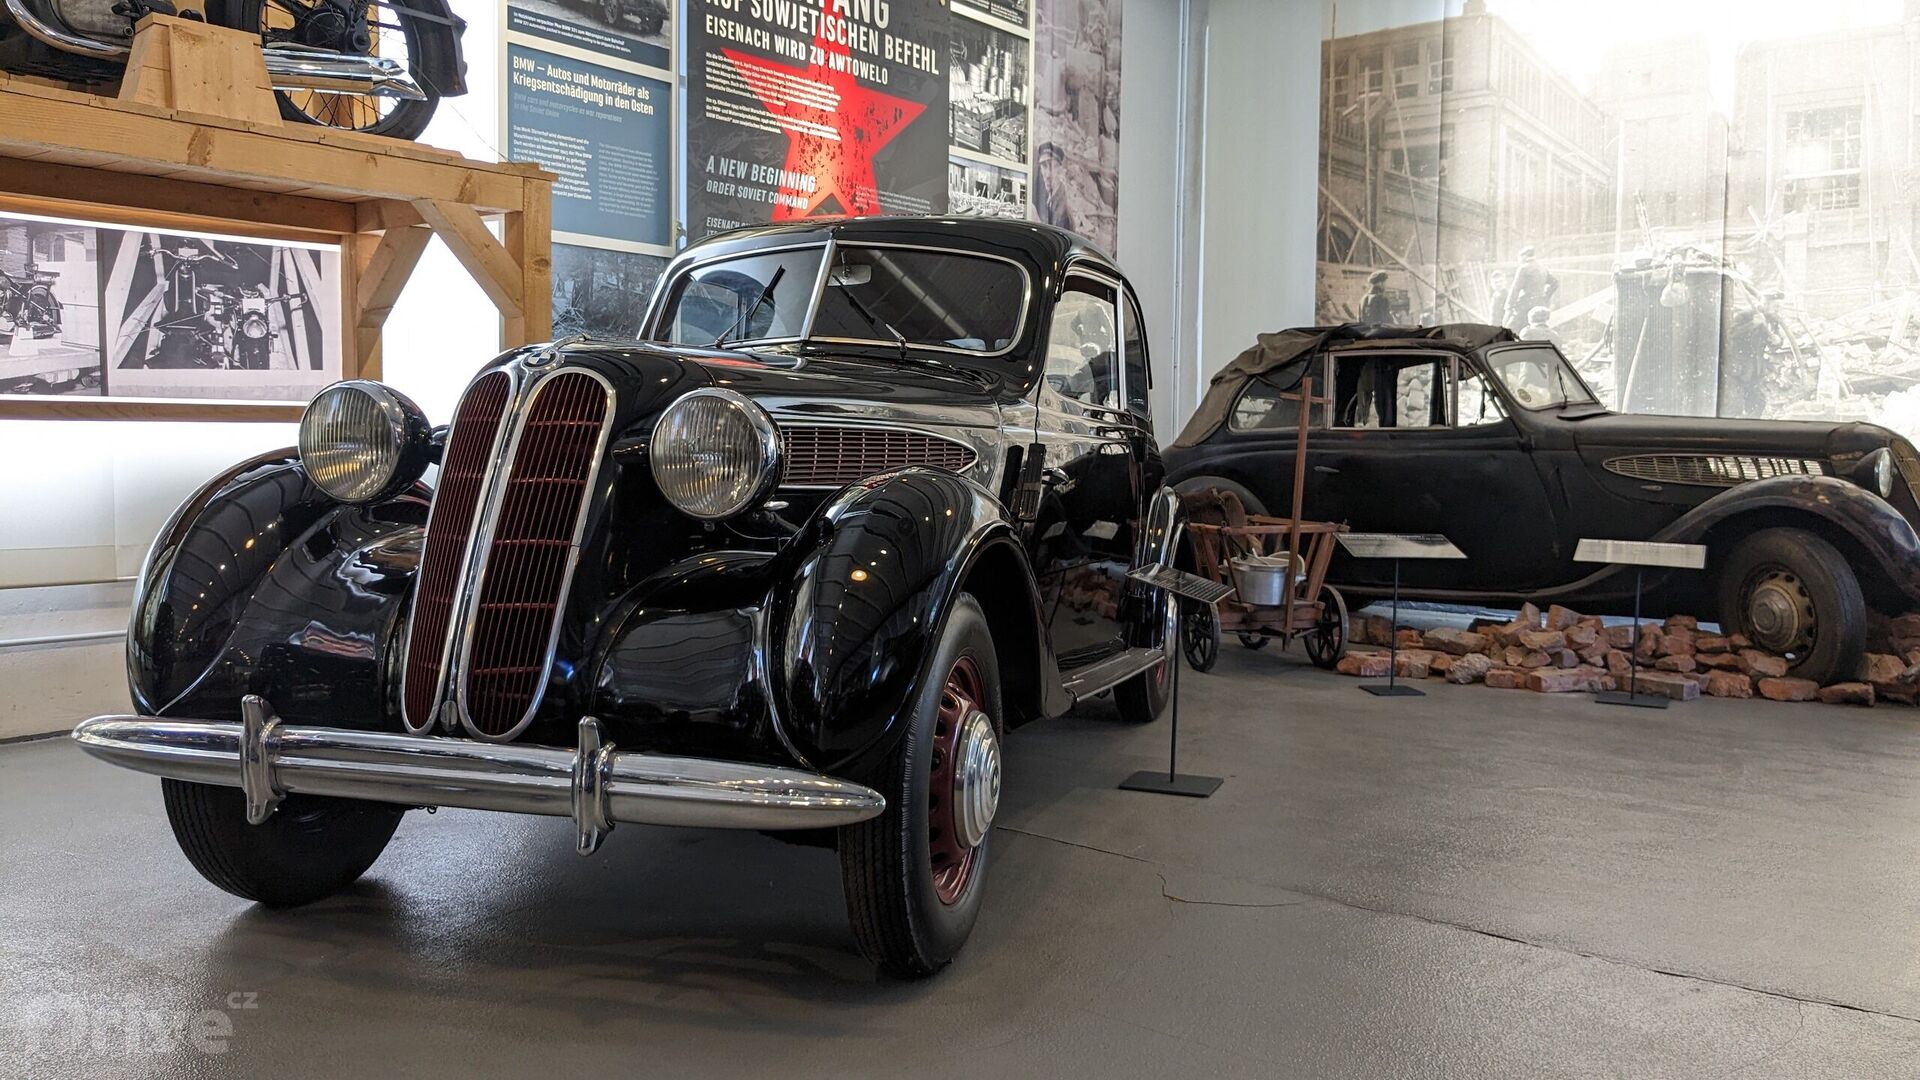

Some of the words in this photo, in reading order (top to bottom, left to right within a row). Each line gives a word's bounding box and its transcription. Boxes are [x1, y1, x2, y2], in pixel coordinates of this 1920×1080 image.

[706, 13, 770, 51] EISENACH
[774, 33, 806, 61] WIRD
[809, 45, 825, 67] ZU
[828, 51, 888, 85] AWTOWELO
[750, 0, 879, 56] SOWJETISCHEN
[884, 33, 940, 76] BEFEHL
[513, 55, 535, 73] BMW
[547, 64, 572, 82] Autos
[573, 72, 590, 86] und
[590, 74, 636, 97] Motorräder
[637, 86, 650, 100] als
[513, 71, 604, 107] Kriegsentschädigung
[605, 92, 614, 106] in
[614, 95, 630, 110] den
[631, 98, 654, 116] Osten
[705, 155, 715, 174] A
[719, 157, 749, 180] NEW
[750, 163, 816, 193] BEGINNING
[706, 180, 736, 197] ORDER
[737, 185, 767, 203] SOVIET
[768, 191, 809, 210] COMMAND
